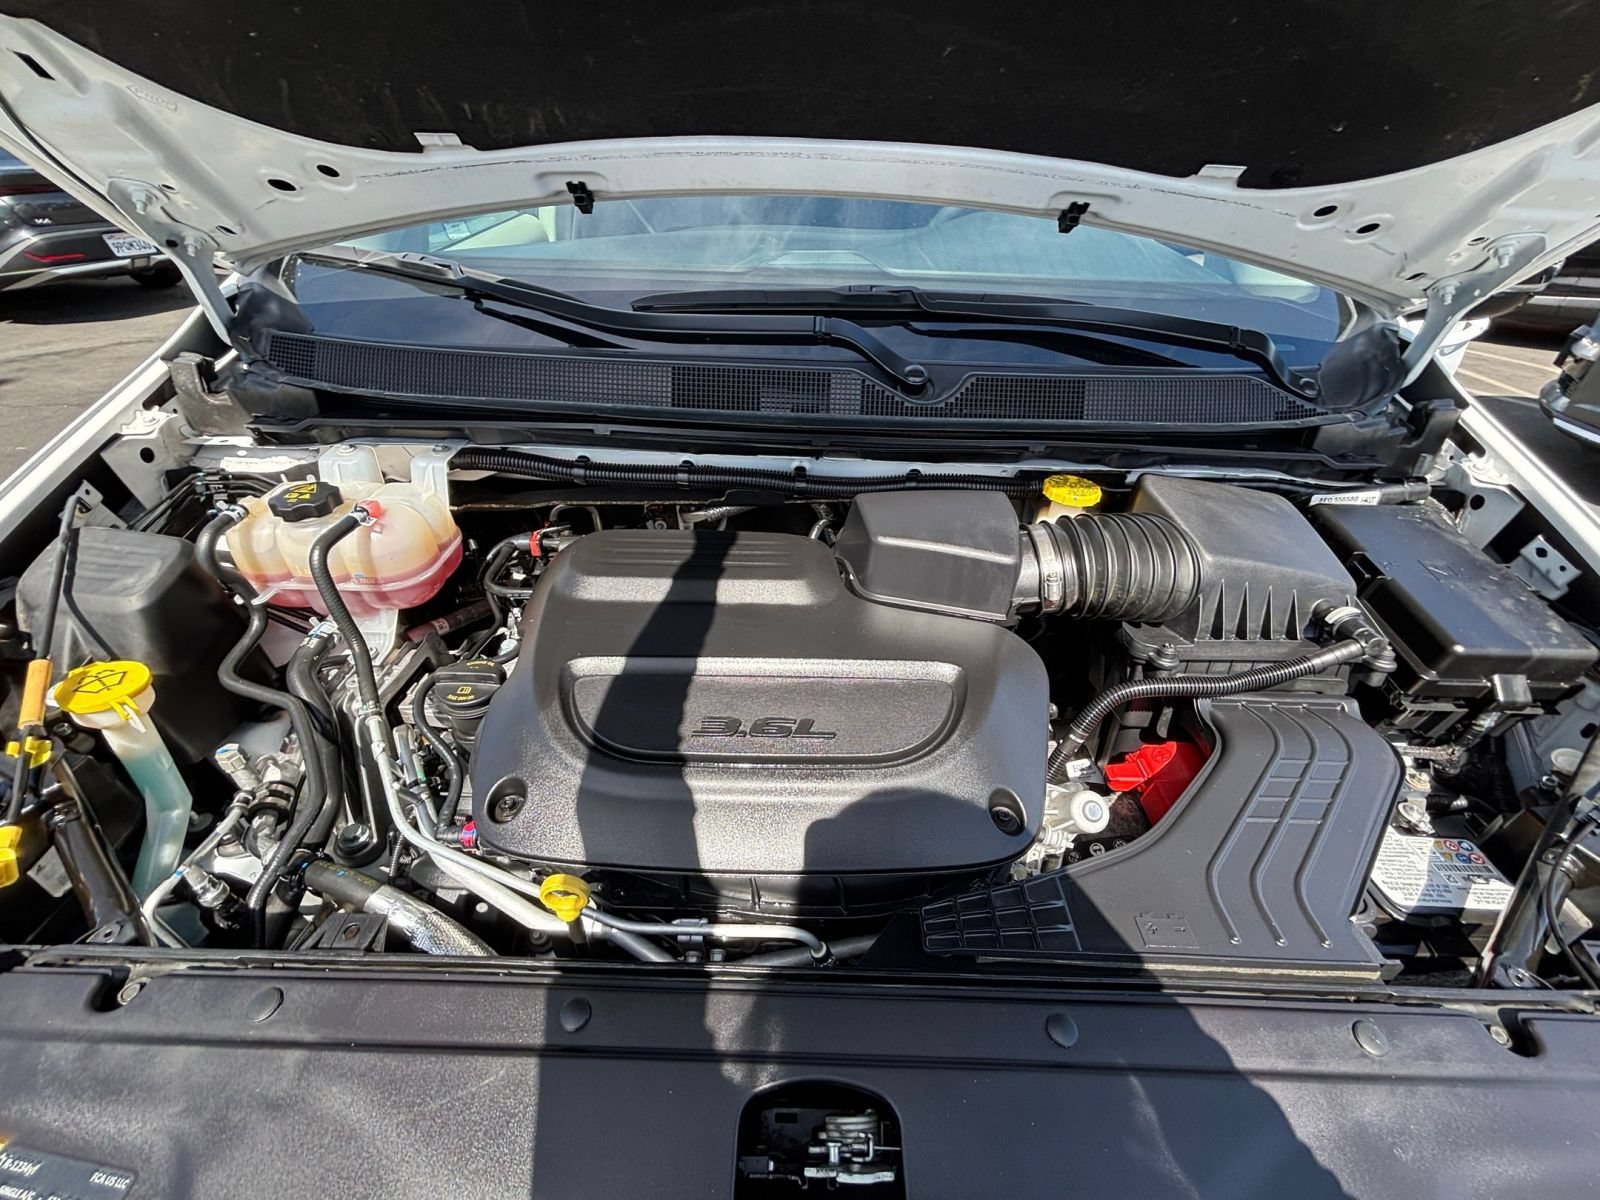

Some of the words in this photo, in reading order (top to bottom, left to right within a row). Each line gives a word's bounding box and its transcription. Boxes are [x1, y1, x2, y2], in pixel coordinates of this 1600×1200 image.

[691, 716, 837, 740] 3.6L
[89, 1172, 105, 1183] FCA
[104, 1174, 116, 1186] US
[115, 1176, 130, 1189] LLC
